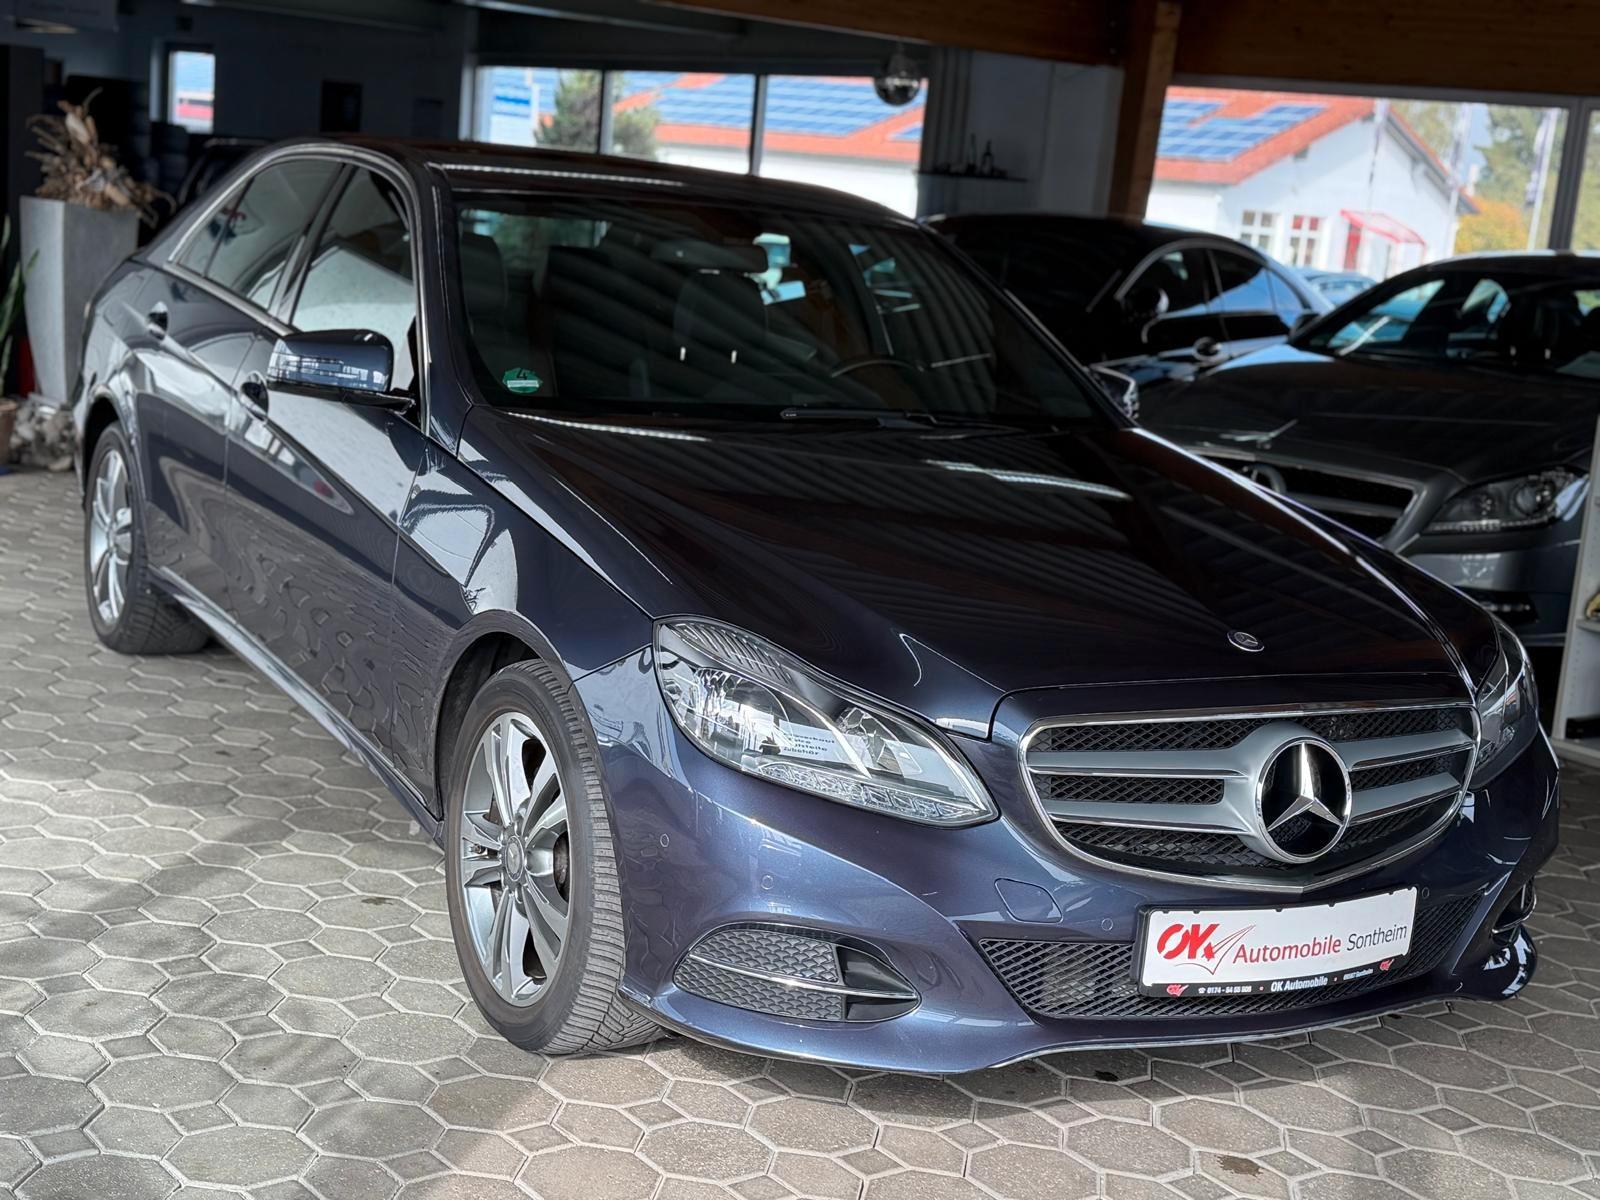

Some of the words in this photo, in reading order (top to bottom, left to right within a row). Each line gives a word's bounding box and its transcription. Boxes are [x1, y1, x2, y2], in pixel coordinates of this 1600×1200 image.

[1157, 923, 1220, 961] OK
[1233, 938, 1342, 964] Automobile
[1347, 924, 1407, 951] Sontheim
[1270, 981, 1285, 992] OK
[1283, 975, 1328, 991] Automobile
